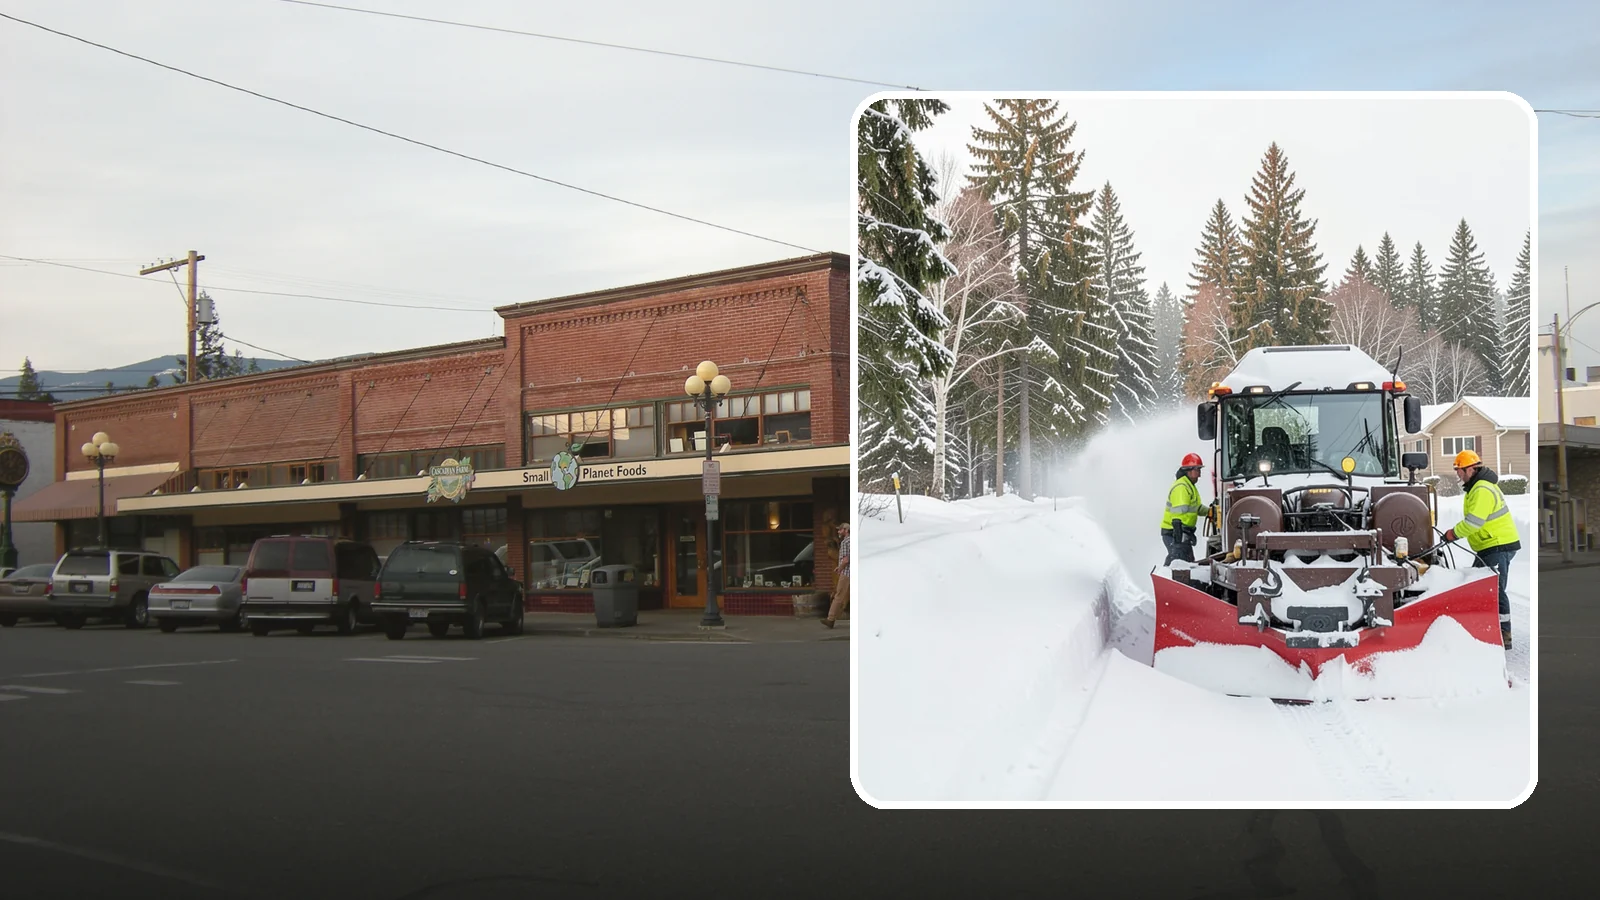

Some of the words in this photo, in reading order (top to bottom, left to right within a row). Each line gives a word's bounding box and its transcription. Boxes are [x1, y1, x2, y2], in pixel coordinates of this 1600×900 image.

[523, 470, 548, 482] Small
[583, 467, 614, 479] Planet
[617, 464, 647, 476] Foods
